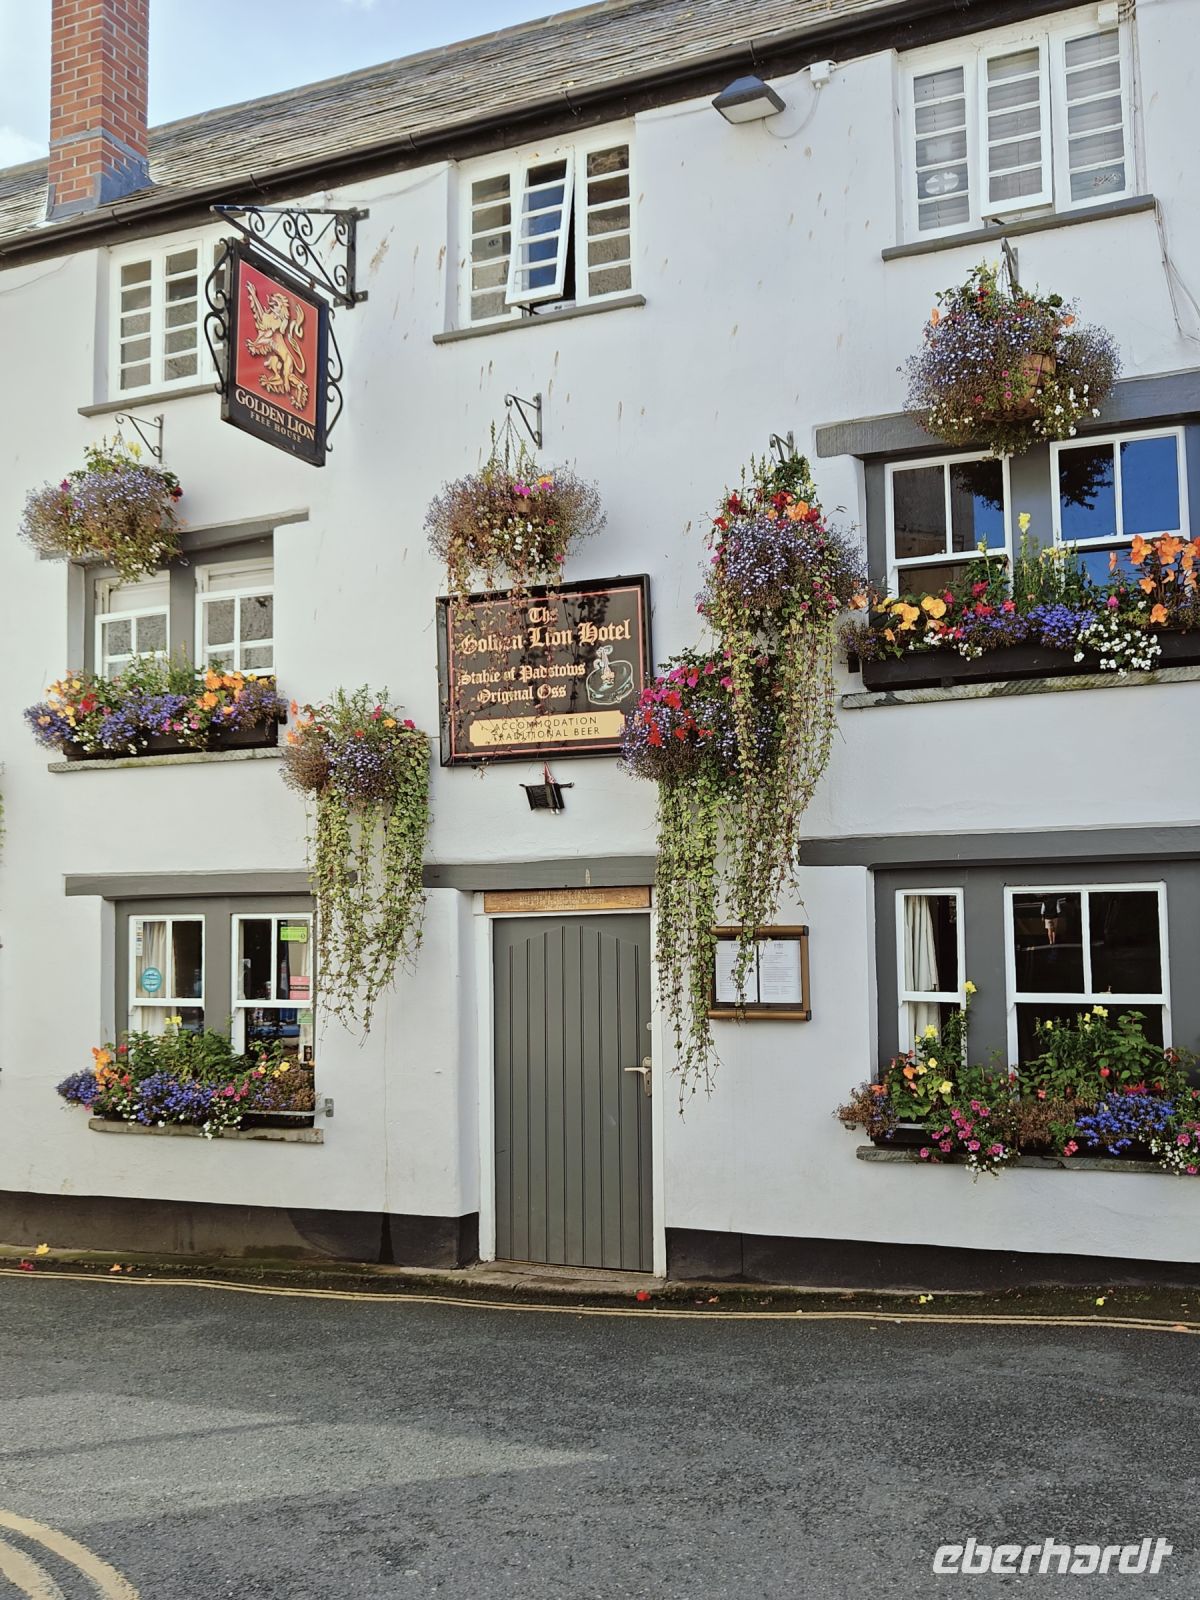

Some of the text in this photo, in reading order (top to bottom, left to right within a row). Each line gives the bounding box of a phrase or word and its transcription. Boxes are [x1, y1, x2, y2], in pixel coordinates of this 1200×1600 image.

[235, 389, 315, 440] GOLDEN LION
[250, 412, 301, 443] FREE HOUSE
[461, 618, 631, 655] Goln Lion Hotel
[503, 666, 516, 681] of
[519, 662, 586, 683] Padstows
[537, 683, 567, 699] Oss
[492, 726, 600, 741] TRADITIONAL BEER
[493, 716, 597, 731] ACCOMMODATION
